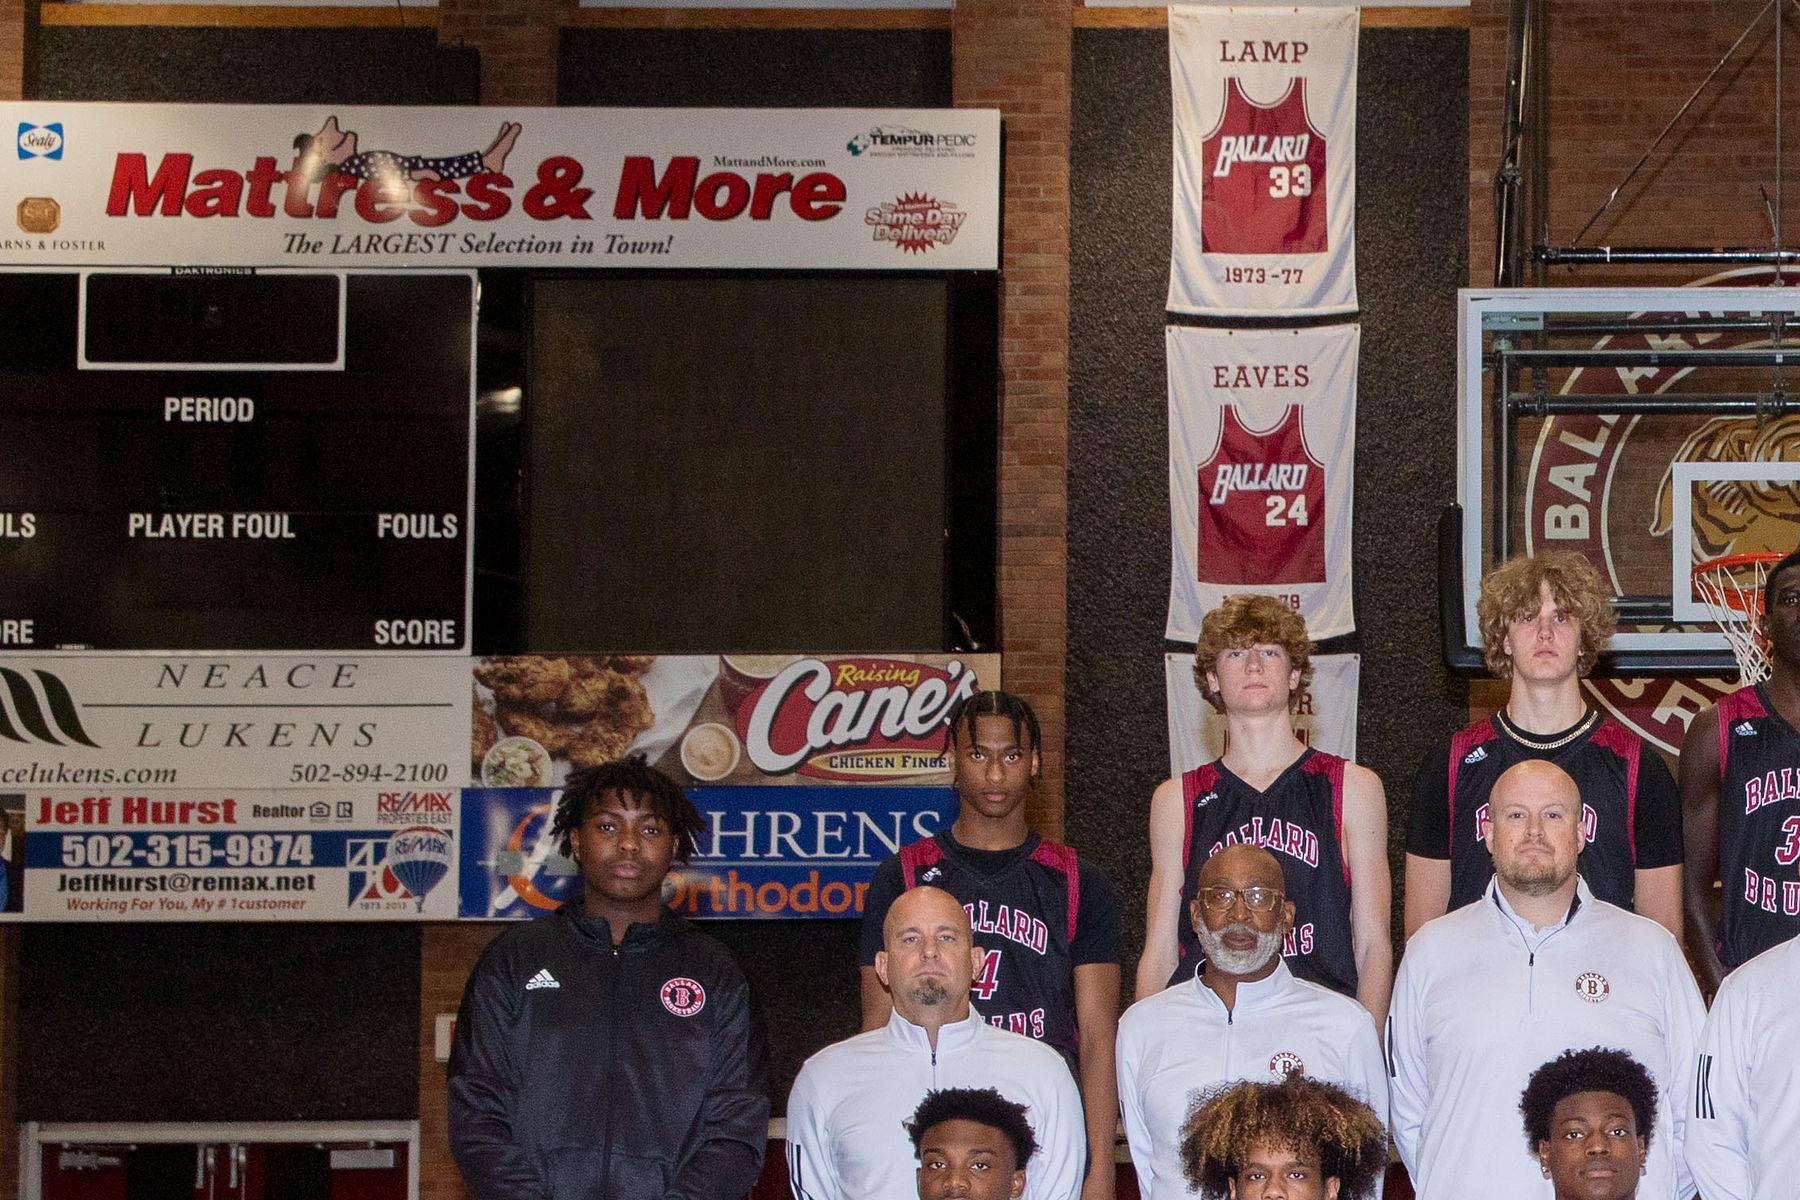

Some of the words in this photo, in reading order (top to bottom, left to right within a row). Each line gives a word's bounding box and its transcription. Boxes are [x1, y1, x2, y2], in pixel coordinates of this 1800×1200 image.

[1220, 40, 1309, 63] LAMP
[24, 133, 55, 149] Sealy
[713, 155, 827, 168] MattandMore.com
[1213, 133, 1310, 178] BALLARD
[105, 153, 513, 228] Mattress
[522, 156, 595, 221] &
[613, 156, 847, 221] More
[1269, 164, 1311, 198] 33
[864, 207, 925, 226] Same
[926, 208, 968, 229] Day
[38, 240, 47, 250] &
[53, 241, 106, 251] FOSTER
[283, 233, 323, 255] The
[331, 233, 456, 256] LARGEST
[460, 233, 566, 256] Selection
[571, 235, 595, 255] in
[605, 234, 674, 255] Town!
[873, 224, 959, 245] Delivery
[175, 267, 252, 275] DAKTRONICS
[1214, 365, 1310, 388] EAVES
[164, 397, 254, 422] PERIOD
[1209, 463, 1308, 505] BALLARD
[1266, 495, 1308, 527] 24
[129, 513, 224, 538] PLAYER
[233, 513, 296, 538] FOUL
[377, 513, 458, 539] FOULS
[375, 619, 456, 644] SCORE
[157, 664, 360, 689] NEACE
[835, 664, 920, 687] Raising
[747, 658, 978, 772] Cane's
[137, 723, 378, 747] LUKENS
[829, 755, 895, 769] CHICKEN
[901, 755, 950, 769] FINGE
[290, 764, 448, 784] 502-894-2100
[36, 797, 111, 824] Jeff
[122, 797, 237, 825] Hurst
[253, 804, 305, 818] Realtor
[377, 791, 452, 812] RE/MAX
[395, 835, 447, 855] RE/MAX
[690, 811, 940, 858] HRENS
[62, 834, 314, 867] 502-315-9874
[57, 873, 316, 893] JeffHurst@remax.net
[67, 898, 127, 913] Working
[131, 898, 155, 911] For
[159, 898, 190, 912] You,
[192, 898, 214, 913] My
[525, 980, 560, 990] adidas
[971, 950, 1002, 1000] 4
